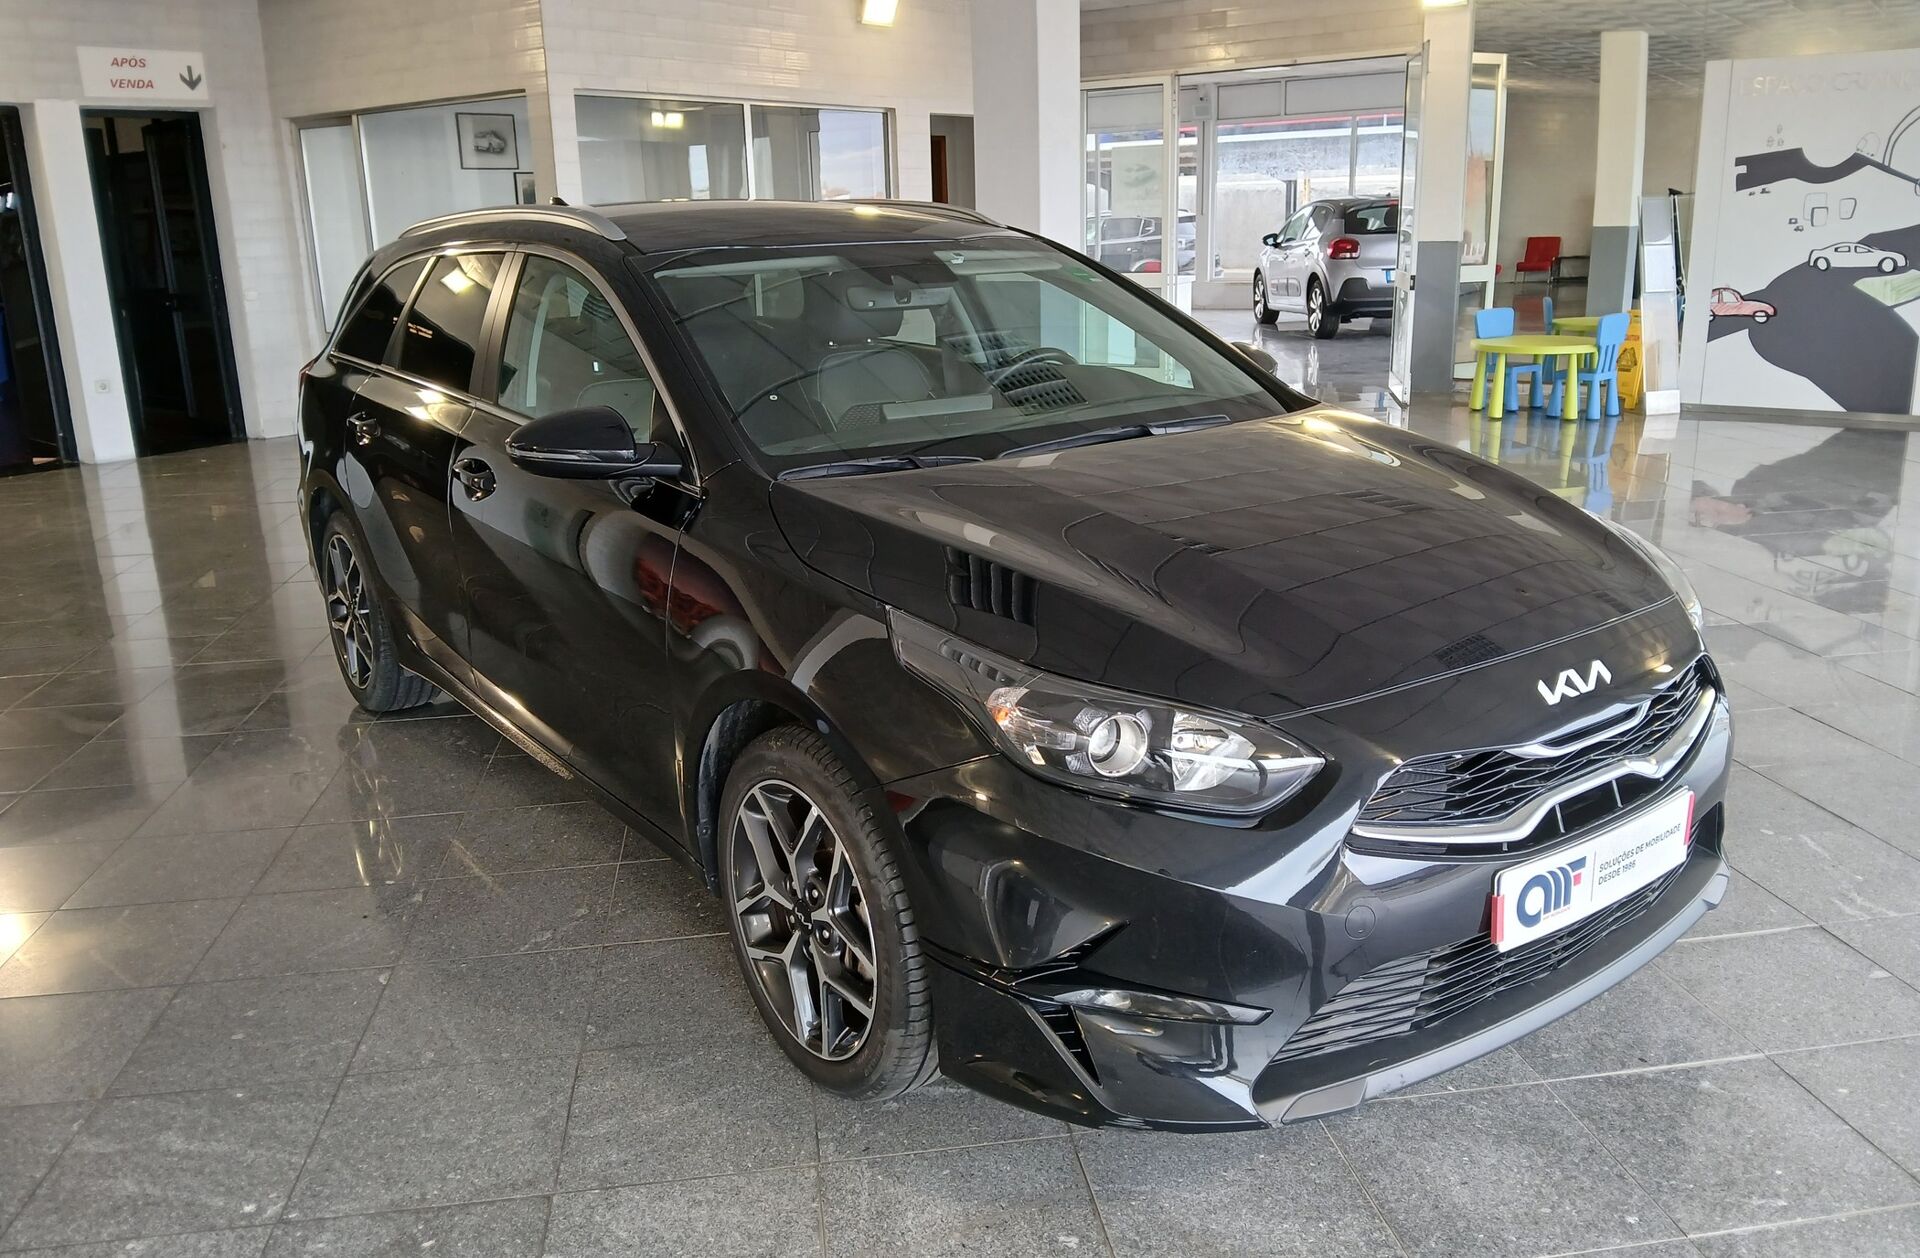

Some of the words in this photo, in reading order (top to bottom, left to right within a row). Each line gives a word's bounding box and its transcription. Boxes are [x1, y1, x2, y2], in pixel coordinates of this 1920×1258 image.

[110, 56, 147, 69] APÓS
[110, 78, 154, 89] VENDA
[1537, 659, 1612, 706] KIA
[1635, 843, 1645, 855] DE
[1598, 867, 1622, 886] DESDE
